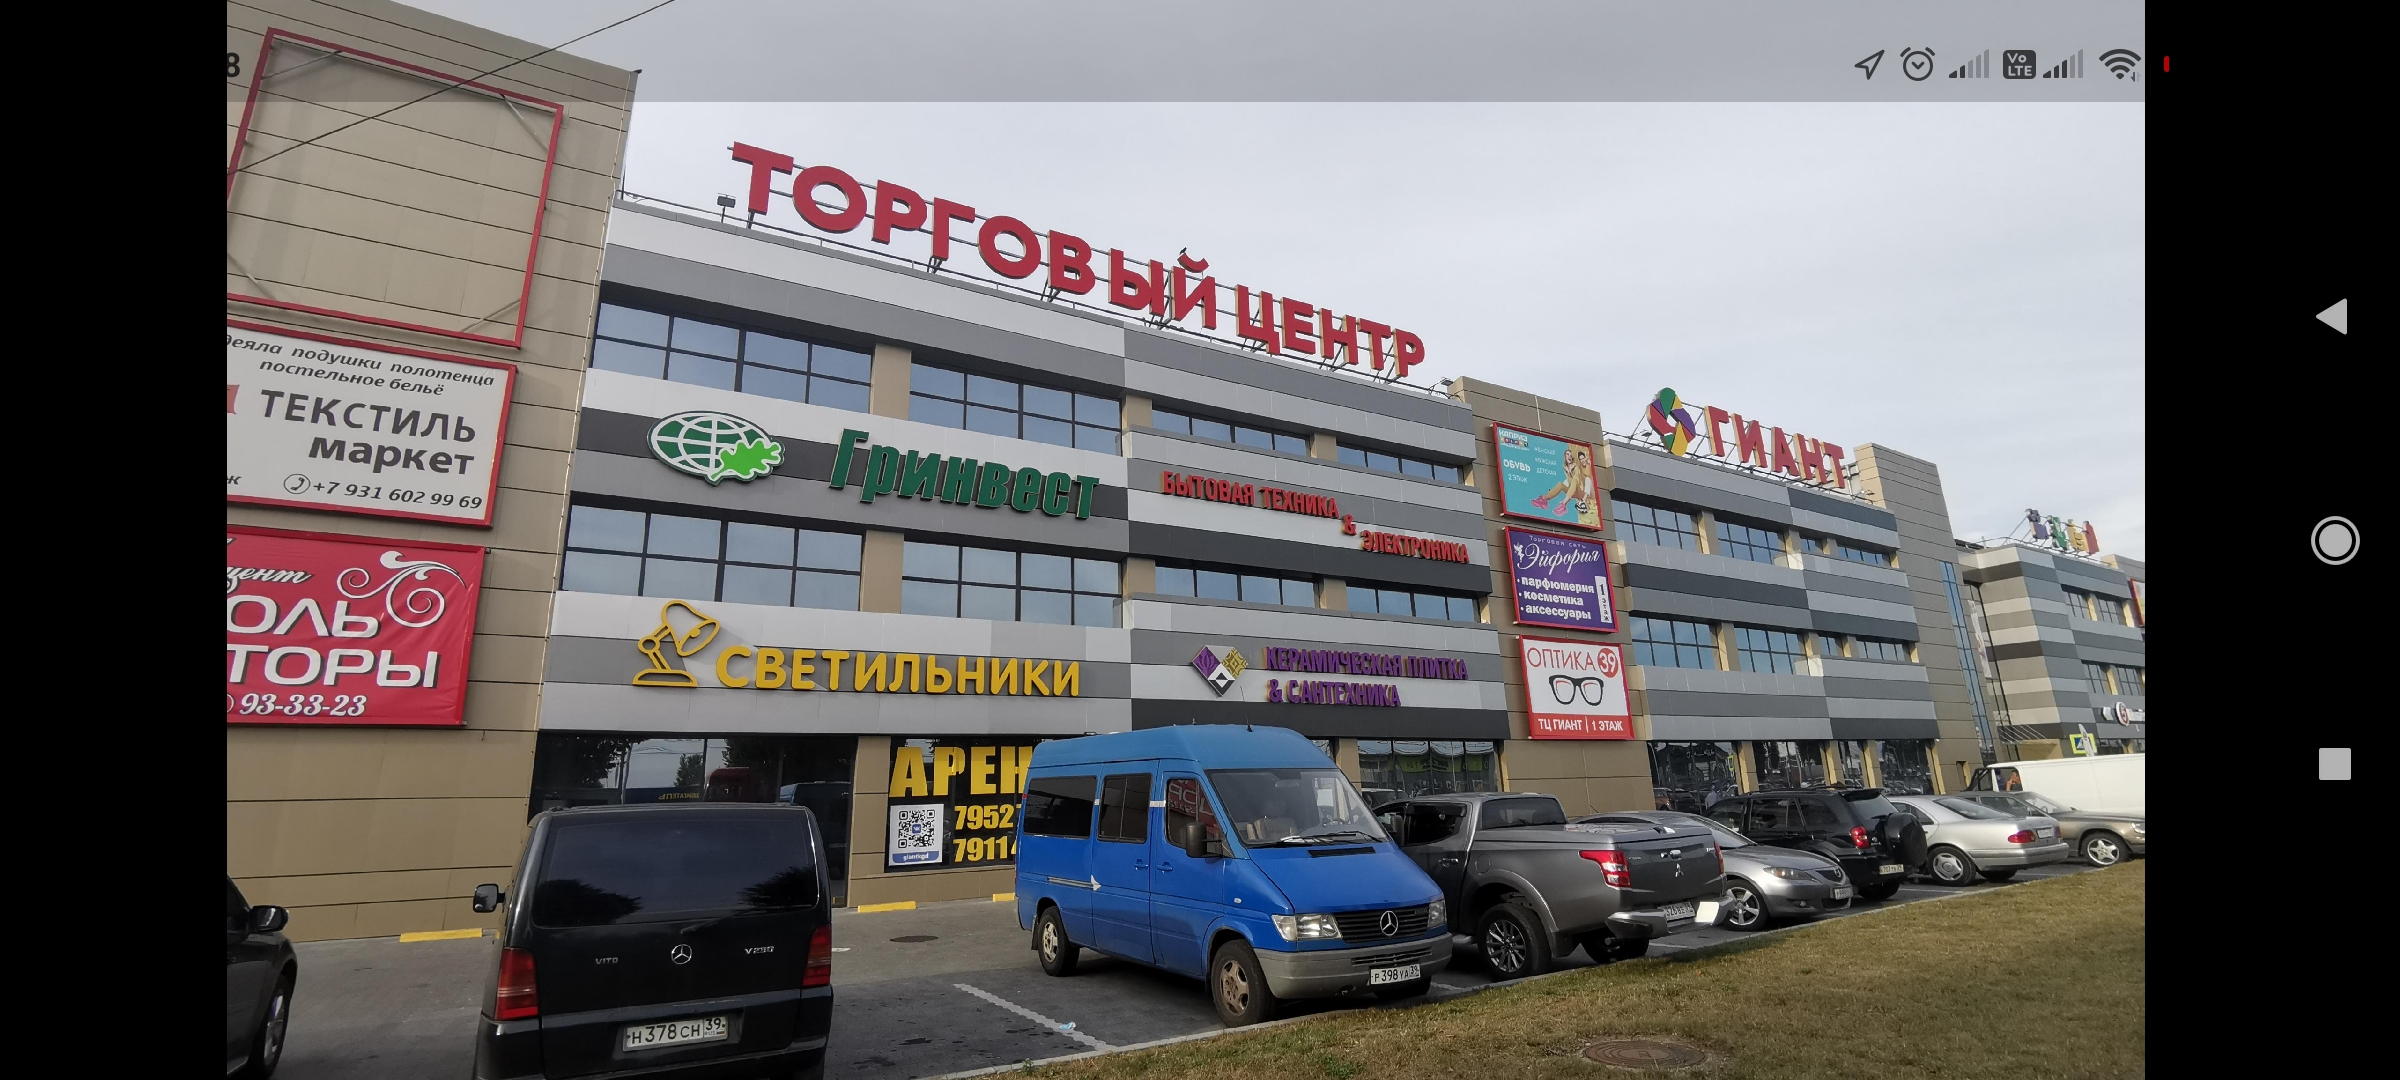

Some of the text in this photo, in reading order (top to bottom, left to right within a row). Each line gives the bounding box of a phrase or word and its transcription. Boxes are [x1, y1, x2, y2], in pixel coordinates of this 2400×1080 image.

[731, 141, 1426, 378] ТОРГОВЫЙ ЦЕНТР
[259, 360, 445, 396] постельное бельё
[291, 347, 382, 370] подушки
[390, 363, 495, 387] полотенца
[260, 389, 476, 443] ТЕКСТИЛЬ
[1498, 429, 1528, 441] КАПРИЗ
[1703, 405, 1846, 489] ГИАНТ
[308, 435, 475, 477] маркет
[1503, 458, 1531, 472] ОБУВЬ
[829, 428, 1100, 520] Гринвест
[313, 481, 483, 509] +7 931 602 99 69
[1162, 470, 1340, 519] БЫТОВАЯ ТЕХНИКА
[1341, 514, 1357, 536] &
[1361, 529, 1471, 564] ЭЛЕКТРОНИКА
[1529, 535, 1565, 546] Торговая
[1517, 543, 1601, 575] Эйфория
[1521, 576, 1595, 594] парфюмерия
[1523, 590, 1584, 606] косметика
[227, 594, 380, 639] ОЛЬ
[1525, 604, 1592, 620] аксессуары
[227, 643, 438, 689] ТОРЫ
[716, 645, 1080, 697] СВЕТИЛЬНИКИ
[1264, 646, 1469, 680] КЕРАМИЧЕСКАЯ ПЛИТКА
[1527, 647, 1597, 672] ОПТИКА
[1600, 652, 1616, 674] 39
[239, 693, 367, 717] 93-33-23
[1268, 678, 1401, 707] & САНТЕХНИКА
[1538, 718, 1624, 732] ТЦ ГИАНТ 1 ЭТАЖ
[889, 745, 1033, 798] АРЕН
[954, 803, 1022, 831] 7952
[953, 836, 1016, 863] 7911
[704, 1018, 722, 1031] 39
